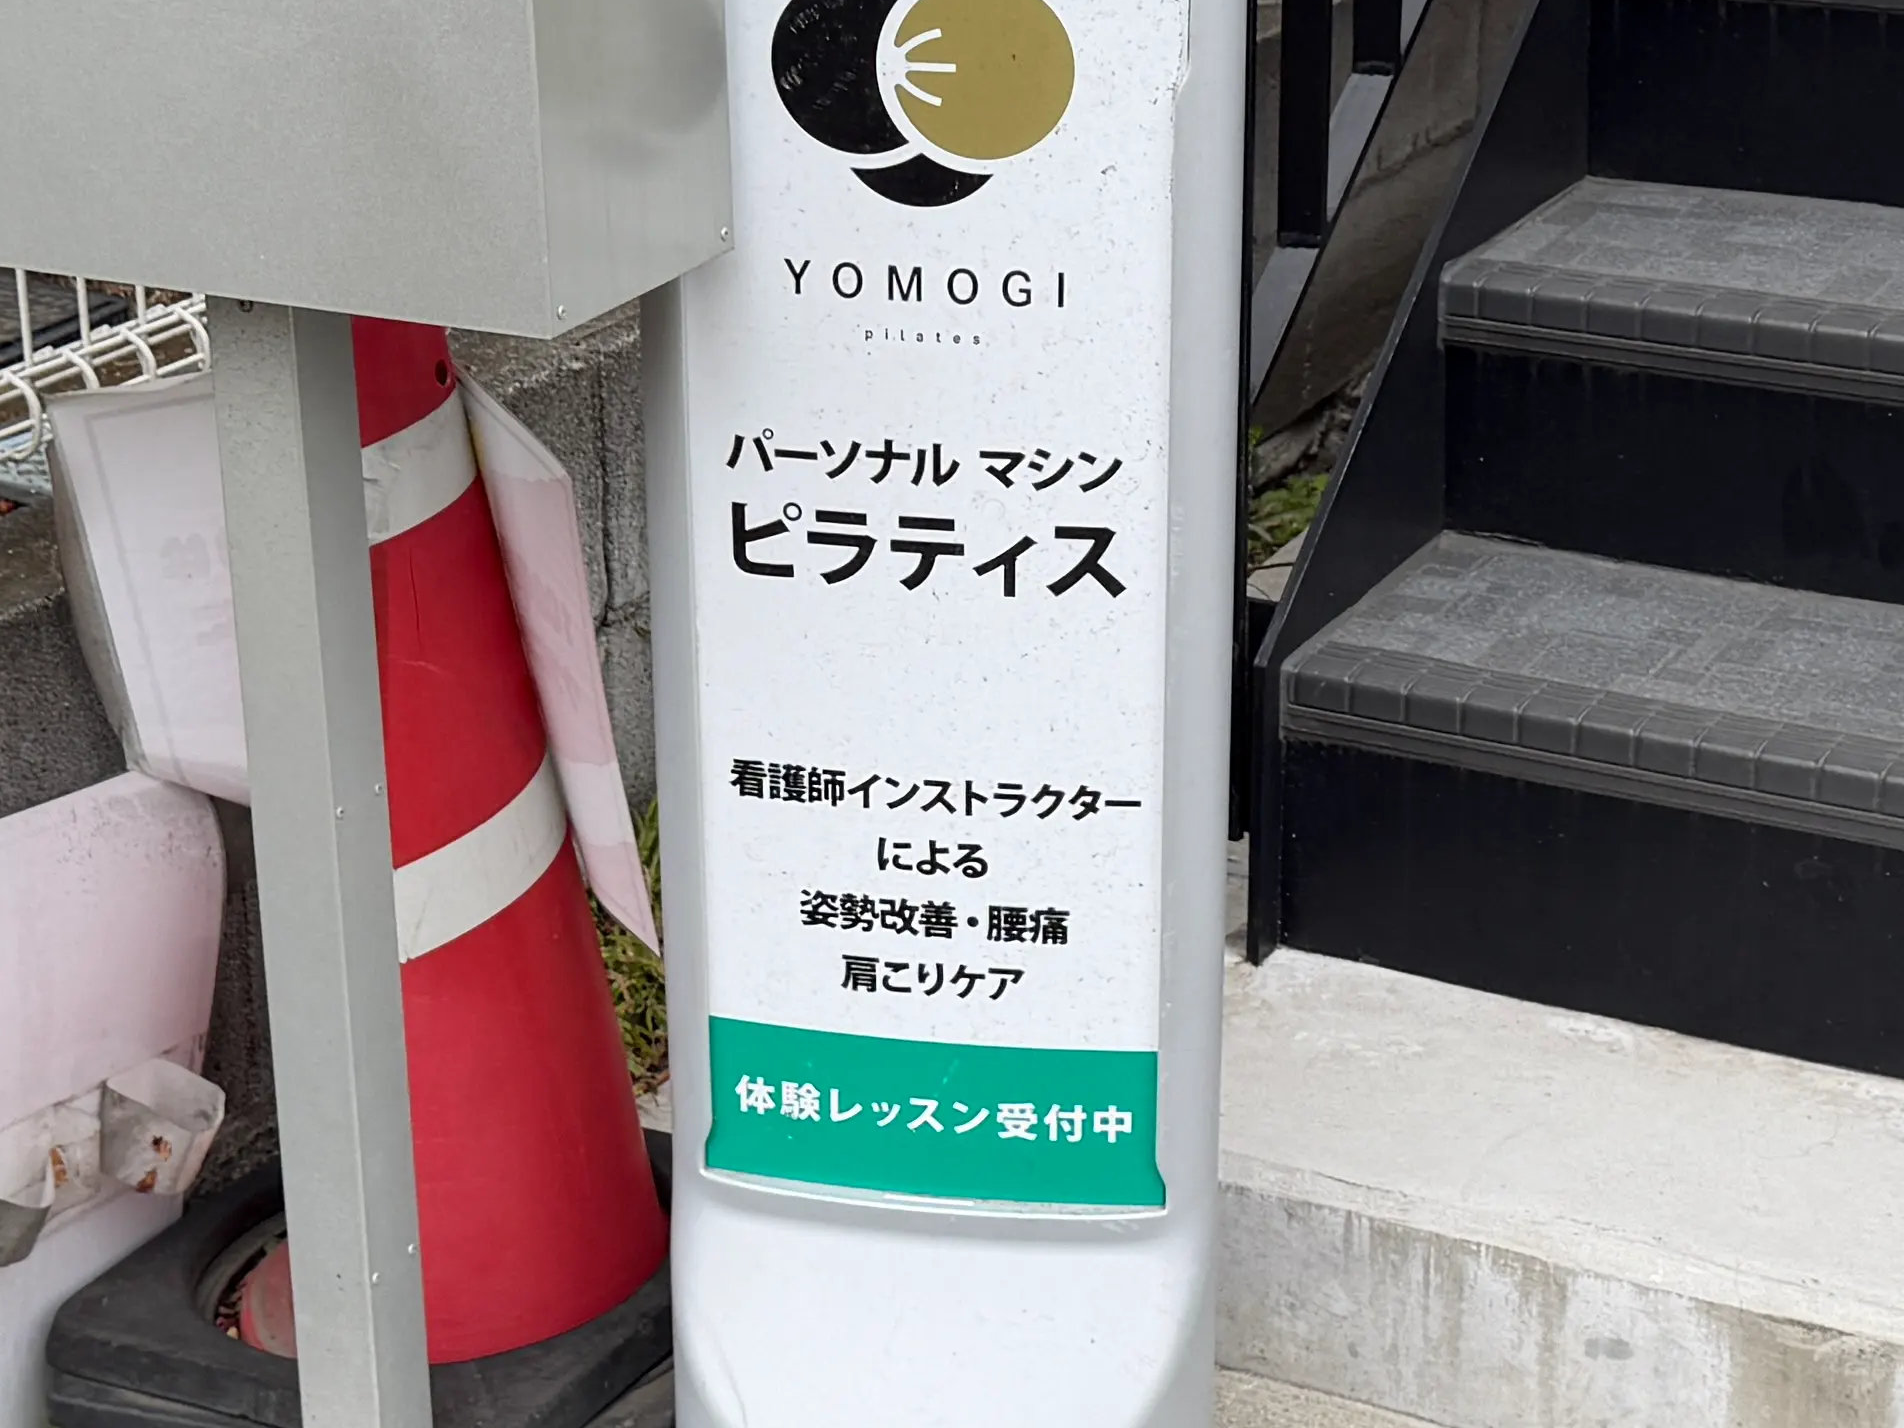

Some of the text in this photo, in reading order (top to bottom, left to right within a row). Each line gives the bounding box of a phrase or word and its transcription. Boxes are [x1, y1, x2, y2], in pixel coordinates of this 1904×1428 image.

[784, 258, 1066, 308] YOMOGI
[864, 326, 982, 346] pilates
[726, 427, 1124, 493] パーソナル マシン
[731, 501, 1128, 599] ピラティス
[729, 758, 1142, 821] 看護師インストラクター
[877, 836, 989, 879] による
[799, 888, 1071, 945] 姿勢改善・腰痛
[840, 954, 1025, 1000] 肩こりケア
[734, 1074, 1133, 1143] 体験レッスン受付中
